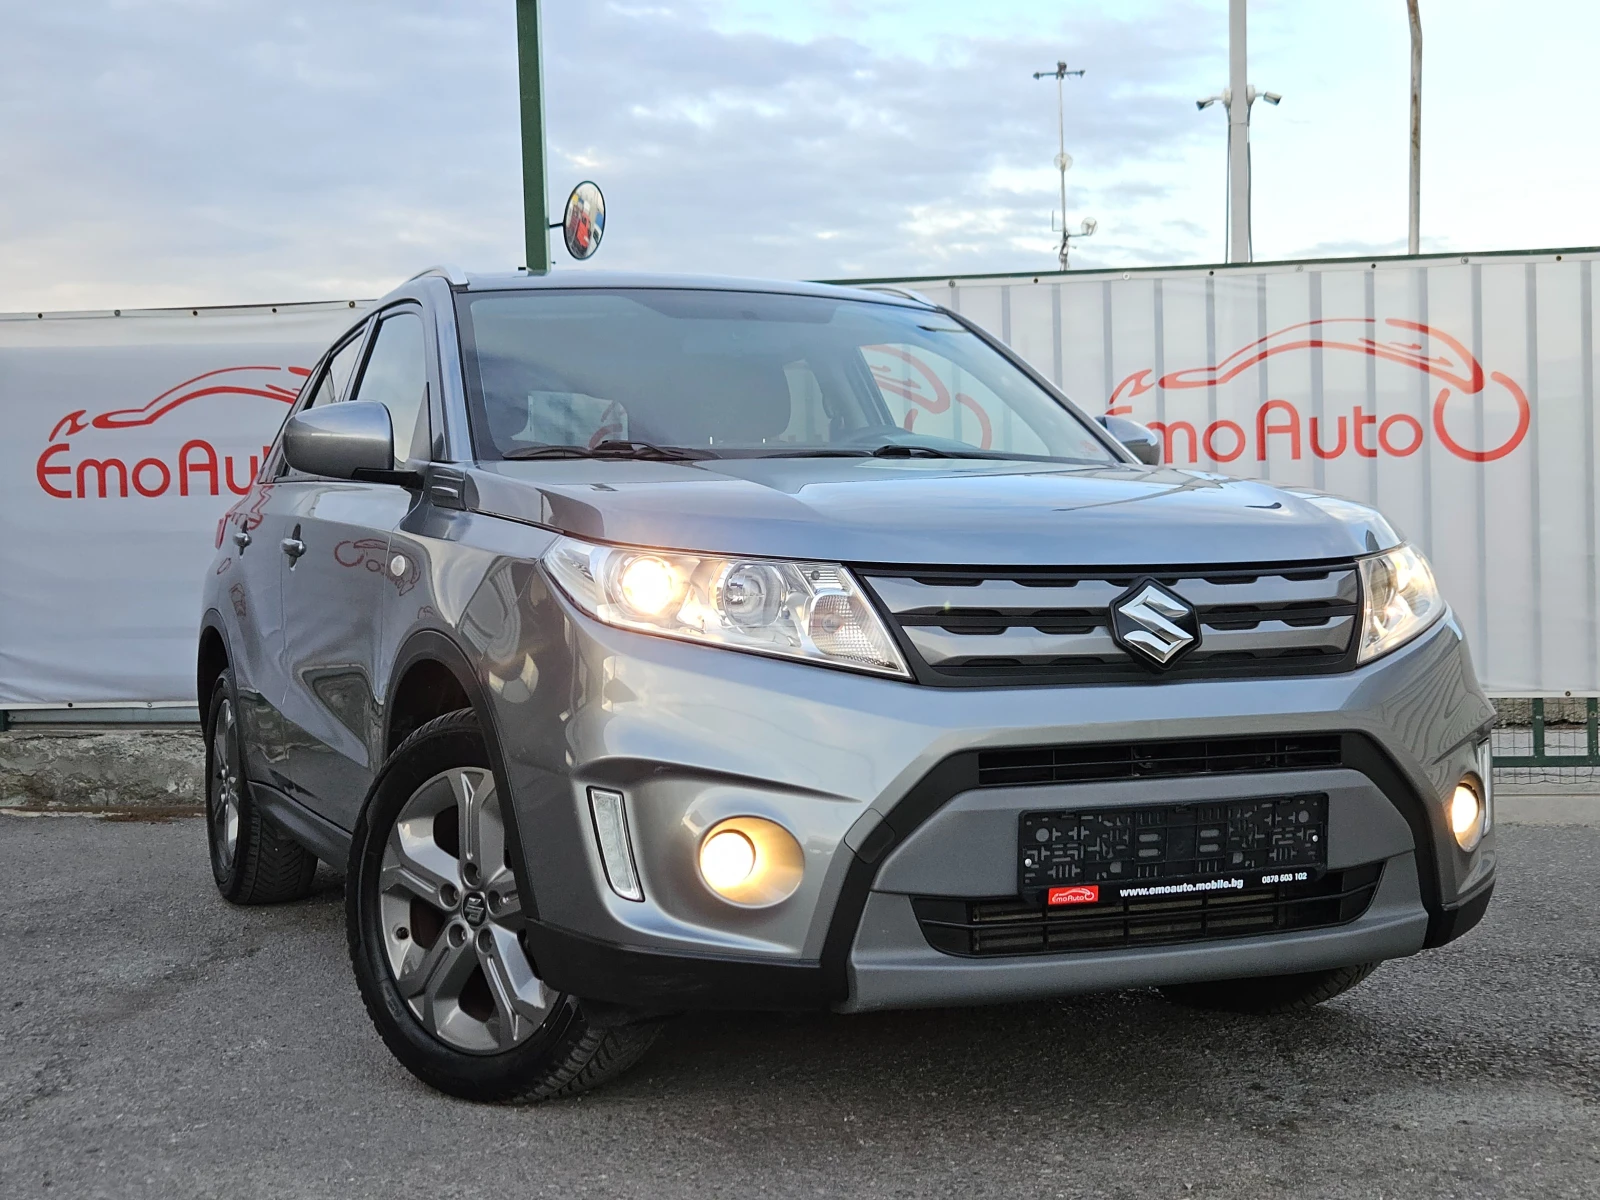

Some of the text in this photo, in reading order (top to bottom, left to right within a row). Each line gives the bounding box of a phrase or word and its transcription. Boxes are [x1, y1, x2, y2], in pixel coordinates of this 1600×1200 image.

[1104, 399, 1424, 464] moAuto
[36, 439, 271, 498] EmoAu
[1119, 878, 1244, 897] www.emoauto.mobile.bg
[1261, 874, 1279, 884] 0878
[1294, 871, 1308, 881] 102
